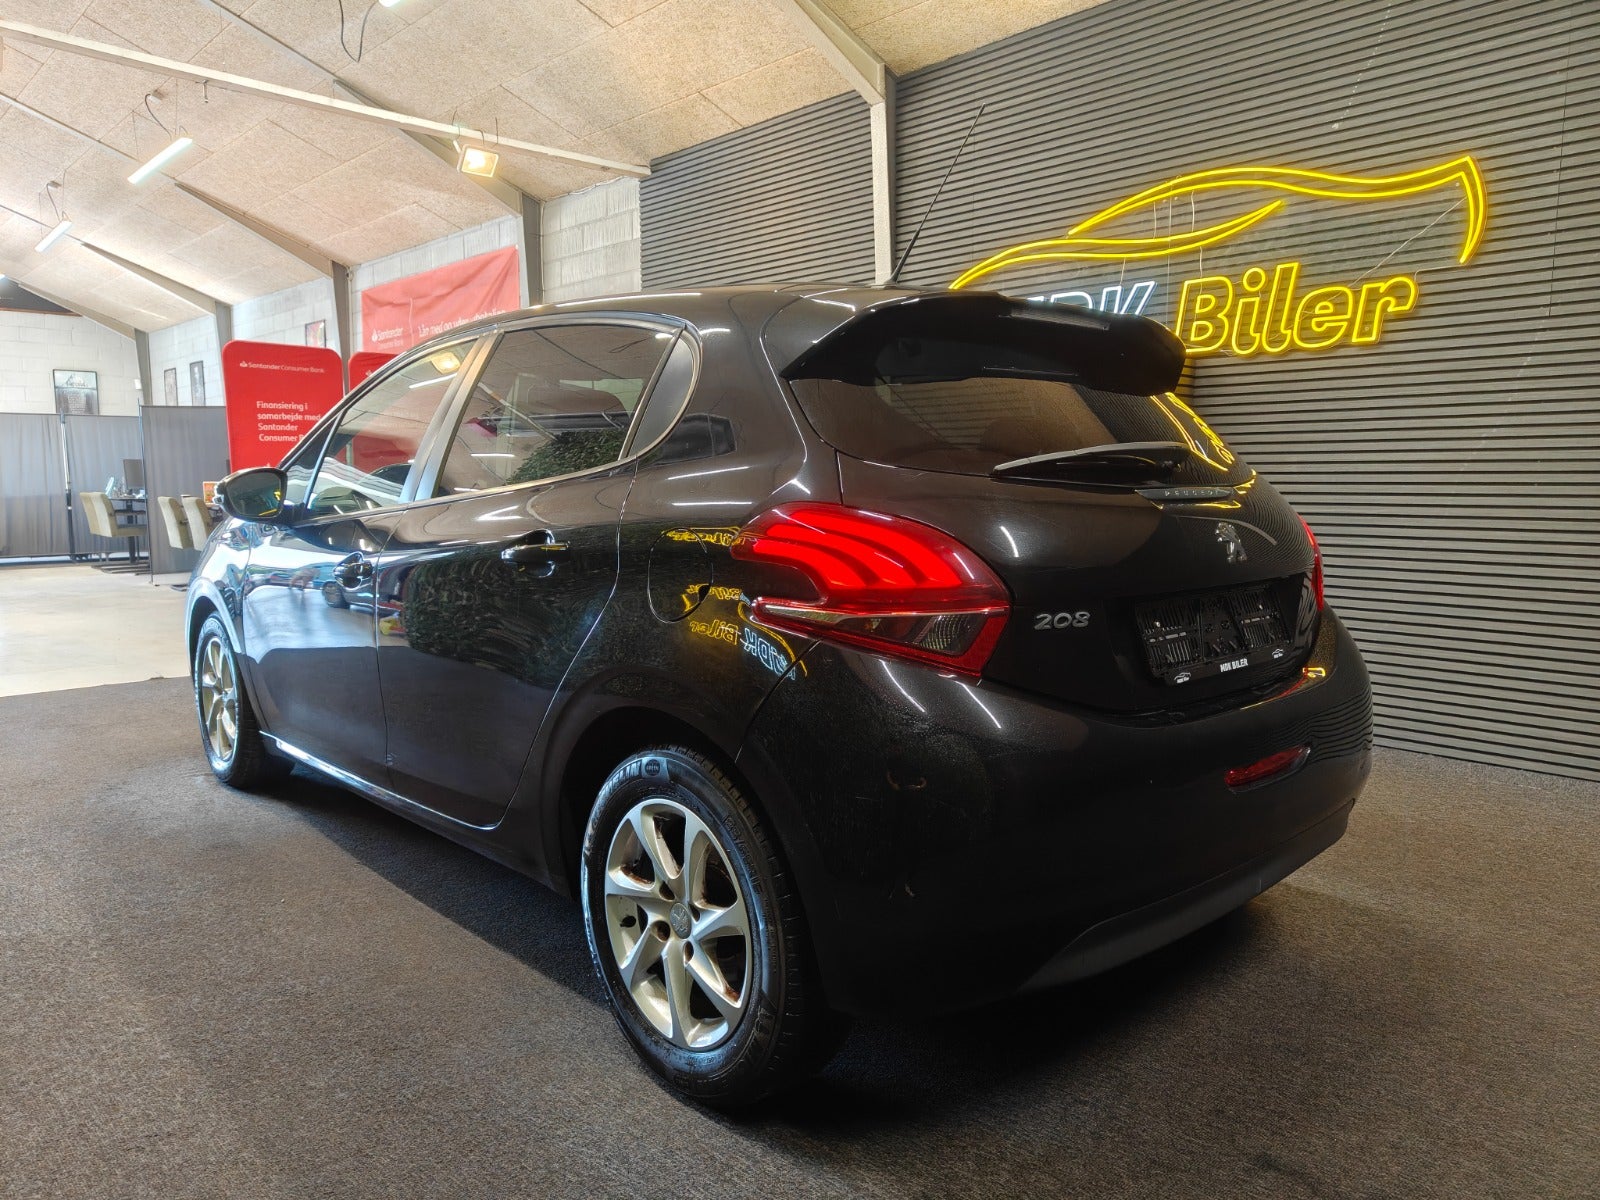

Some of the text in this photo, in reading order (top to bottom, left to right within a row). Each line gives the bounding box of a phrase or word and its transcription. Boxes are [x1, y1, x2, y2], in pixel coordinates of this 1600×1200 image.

[1176, 261, 1419, 355] Biler
[248, 361, 280, 370] Santander
[256, 400, 304, 411] Finansiering
[257, 412, 321, 422] samarbejde med
[257, 422, 298, 431] Santander
[258, 433, 298, 442] Consumer
[1034, 611, 1091, 630] 208
[1231, 658, 1249, 670] BILER
